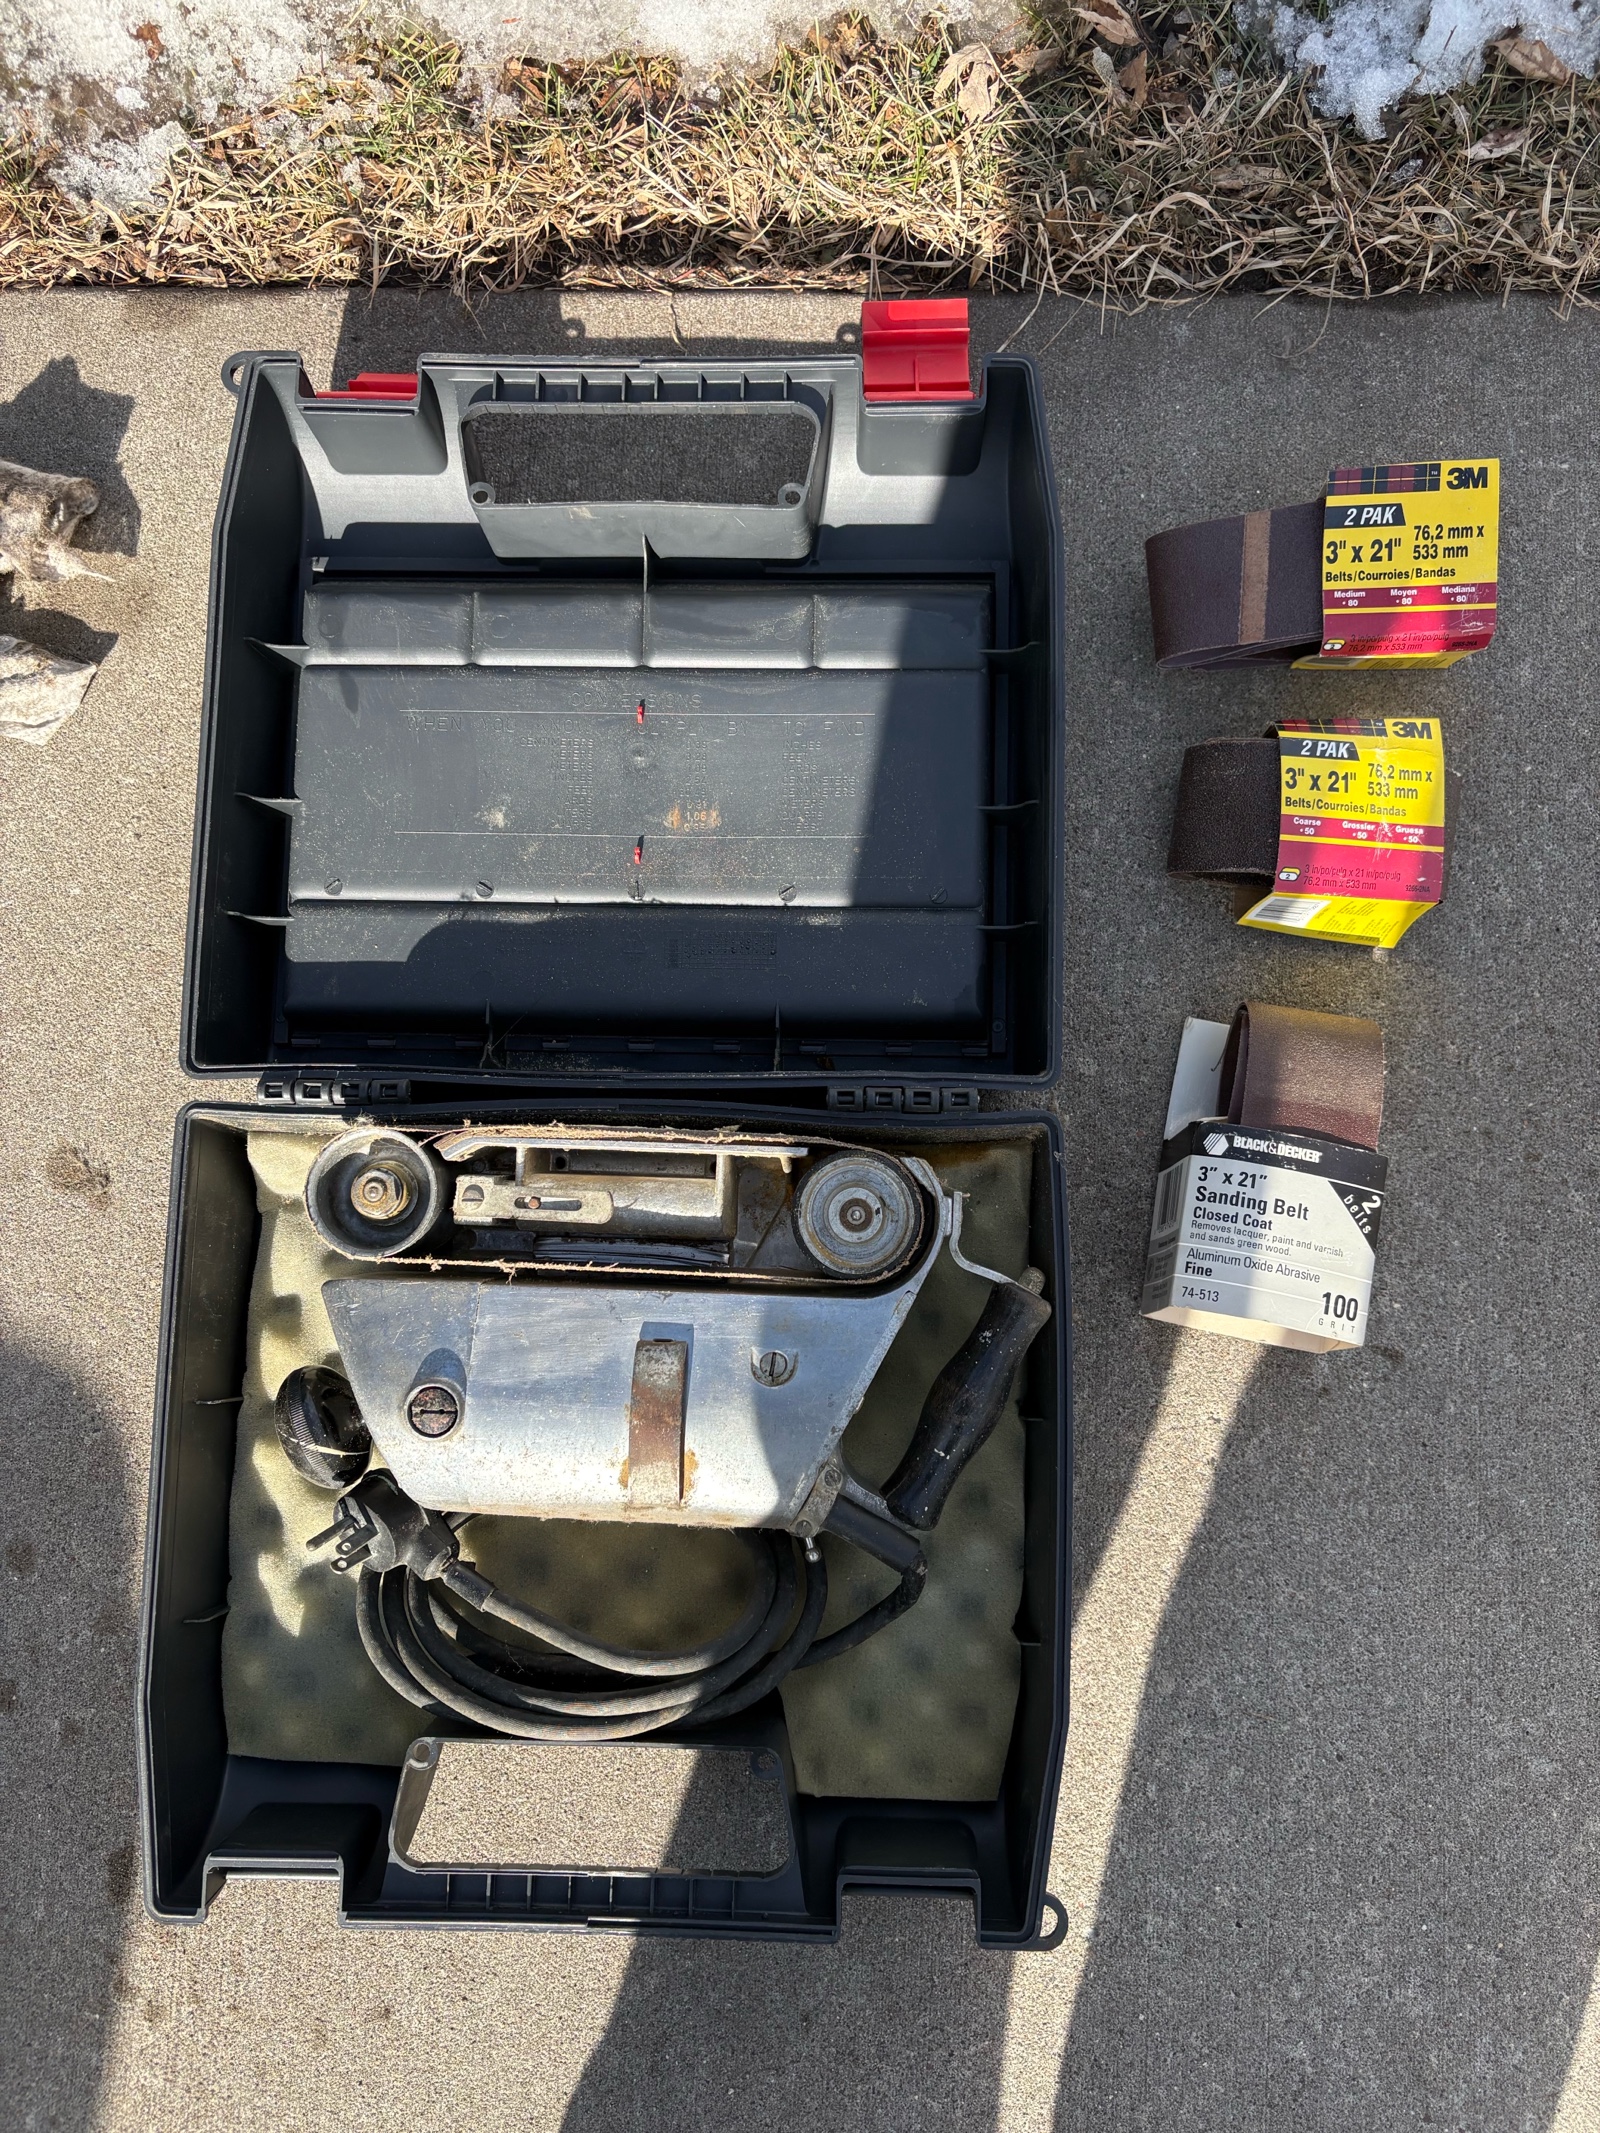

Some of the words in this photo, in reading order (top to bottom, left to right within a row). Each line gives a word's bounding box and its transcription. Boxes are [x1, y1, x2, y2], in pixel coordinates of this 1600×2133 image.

[1446, 467, 1488, 490] 3M
[1344, 508, 1357, 526] 2
[1360, 505, 1397, 525] PAK
[1413, 524, 1443, 543] 76,2
[1447, 526, 1473, 539] mm
[1476, 525, 1485, 538] x
[1325, 540, 1347, 564] 3"
[1350, 546, 1363, 563] x
[1370, 537, 1401, 563] 21"
[1412, 544, 1438, 560] 533
[1443, 545, 1468, 558] mm
[1334, 590, 1366, 598] Medium
[1390, 589, 1418, 597] Moyen
[1442, 585, 1476, 594] Mediana
[1350, 634, 1355, 643] 3
[406, 716, 462, 733] WHEN
[482, 717, 516, 733] YOU
[783, 721, 805, 736] TO
[823, 720, 866, 736] FIND
[1392, 721, 1433, 740] 3M
[520, 737, 594, 749] CENTIMETERS
[1300, 740, 1313, 756] 2
[1316, 740, 1351, 758] PAK
[782, 752, 808, 762] FEET
[1285, 767, 1305, 789] 3"
[1309, 774, 1321, 791] x
[1328, 770, 1357, 793] 21"
[1368, 763, 1395, 782] 76,2
[1398, 768, 1423, 782] mm
[1425, 771, 1433, 783] x
[1367, 781, 1390, 797] 533
[1394, 787, 1418, 800] mm
[1293, 817, 1321, 827] Coarse
[1342, 821, 1376, 831] Grossier
[1395, 825, 1424, 835] Gruesa
[1304, 864, 1310, 873] 3
[1355, 868, 1364, 877] 21
[1322, 879, 1337, 888] mm
[1346, 880, 1360, 889] 533
[1361, 882, 1377, 890] mm
[1233, 1136, 1322, 1164] BLACK&DECKER
[1222, 1172, 1234, 1185] x
[1195, 1186, 1268, 1215] Sanding
[1273, 1198, 1310, 1221] Belt
[1362, 1195, 1381, 1215] 2
[1193, 1206, 1239, 1225] Closed
[1243, 1214, 1273, 1231] Coat
[1343, 1194, 1372, 1235] belts
[1189, 1231, 1206, 1241] and
[1208, 1234, 1235, 1246] sands
[1237, 1239, 1263, 1252] green
[1265, 1244, 1292, 1257] wood.
[1191, 1220, 1233, 1235] Removes
[1233, 1225, 1270, 1243] lacquer,
[1272, 1235, 1295, 1248] paint
[1296, 1238, 1312, 1250] and
[1313, 1243, 1344, 1258] varnish
[1184, 1261, 1213, 1277] Fine
[1186, 1248, 1241, 1267] Aluminum
[1243, 1257, 1274, 1273] Oxide
[1275, 1265, 1321, 1284] Abrasive
[1181, 1286, 1220, 1303] 74-513
[1321, 1292, 1359, 1322] 100
